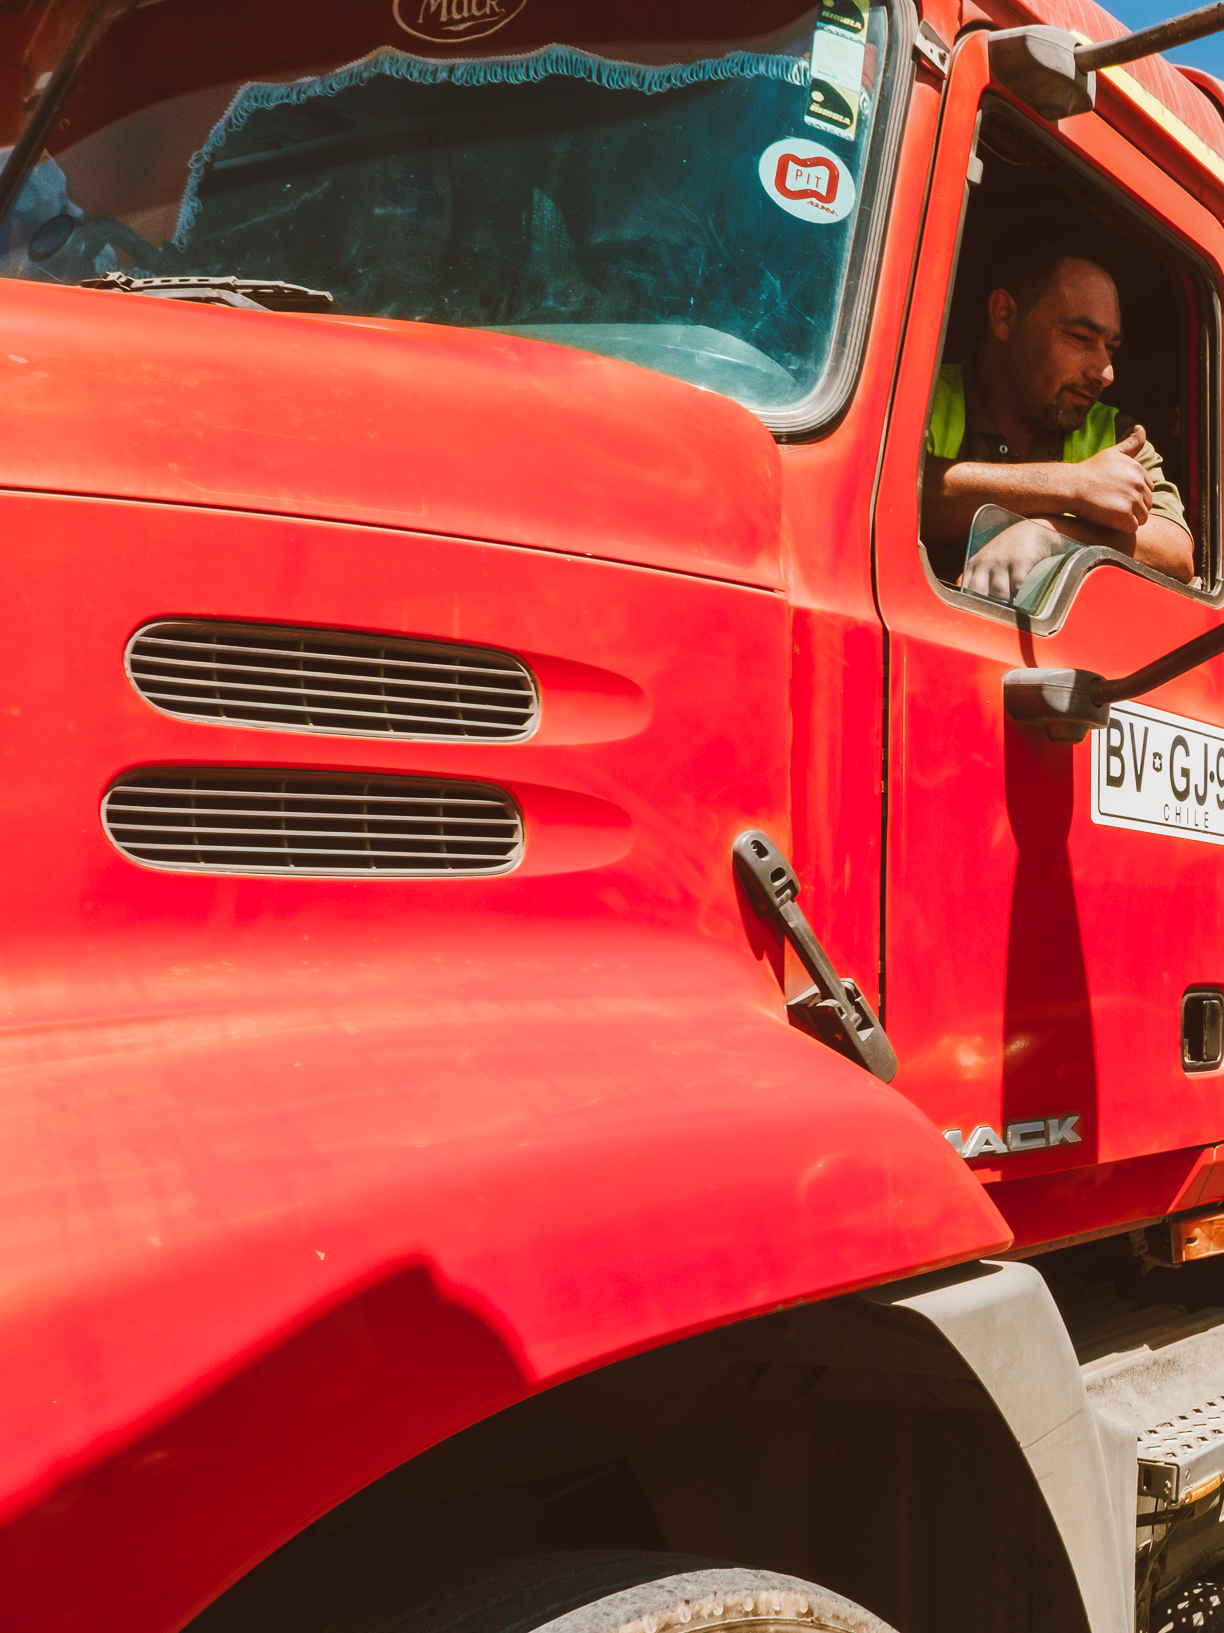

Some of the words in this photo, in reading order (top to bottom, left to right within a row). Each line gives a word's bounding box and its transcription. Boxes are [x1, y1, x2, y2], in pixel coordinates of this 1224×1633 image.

[794, 168, 822, 189] PIT
[1106, 716, 1149, 793] BV
[1163, 803, 1210, 829] CHILE
